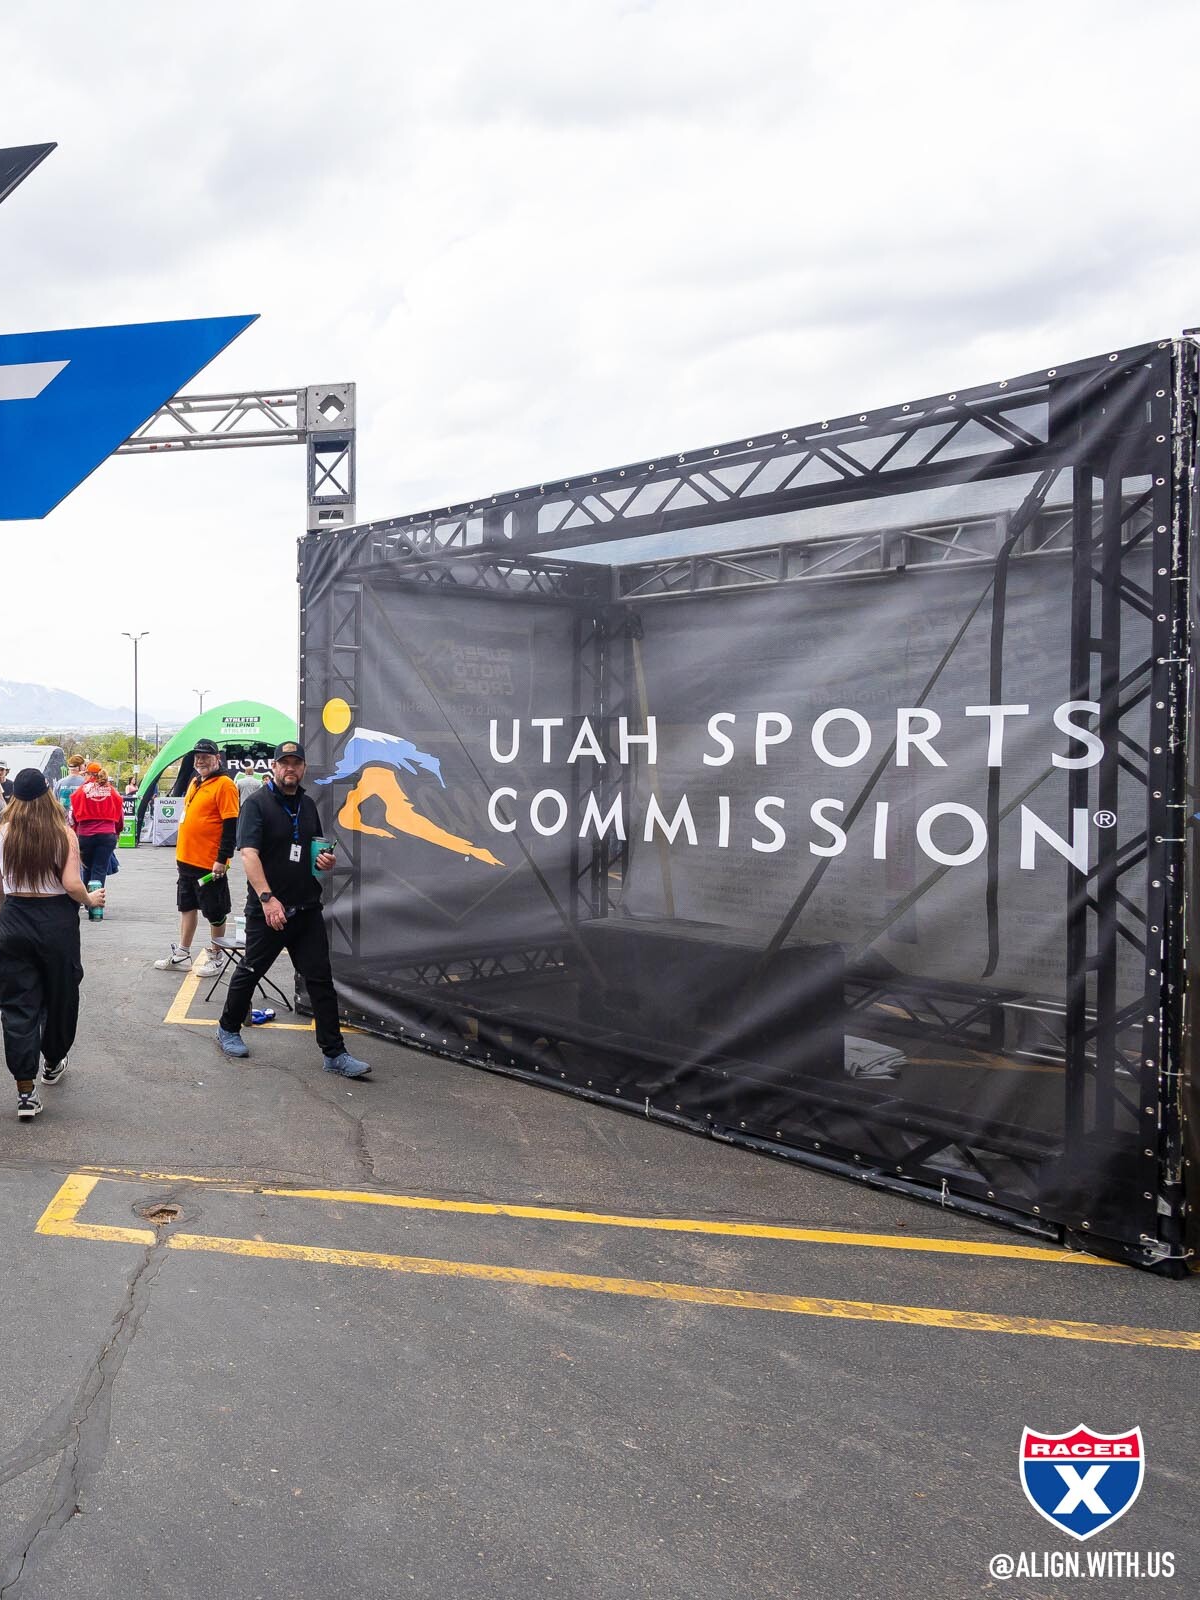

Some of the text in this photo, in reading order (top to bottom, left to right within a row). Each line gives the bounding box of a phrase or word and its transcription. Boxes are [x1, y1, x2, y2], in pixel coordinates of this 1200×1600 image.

[488, 700, 1105, 770] UTAH SPORTS
[165, 808, 171, 817] 2
